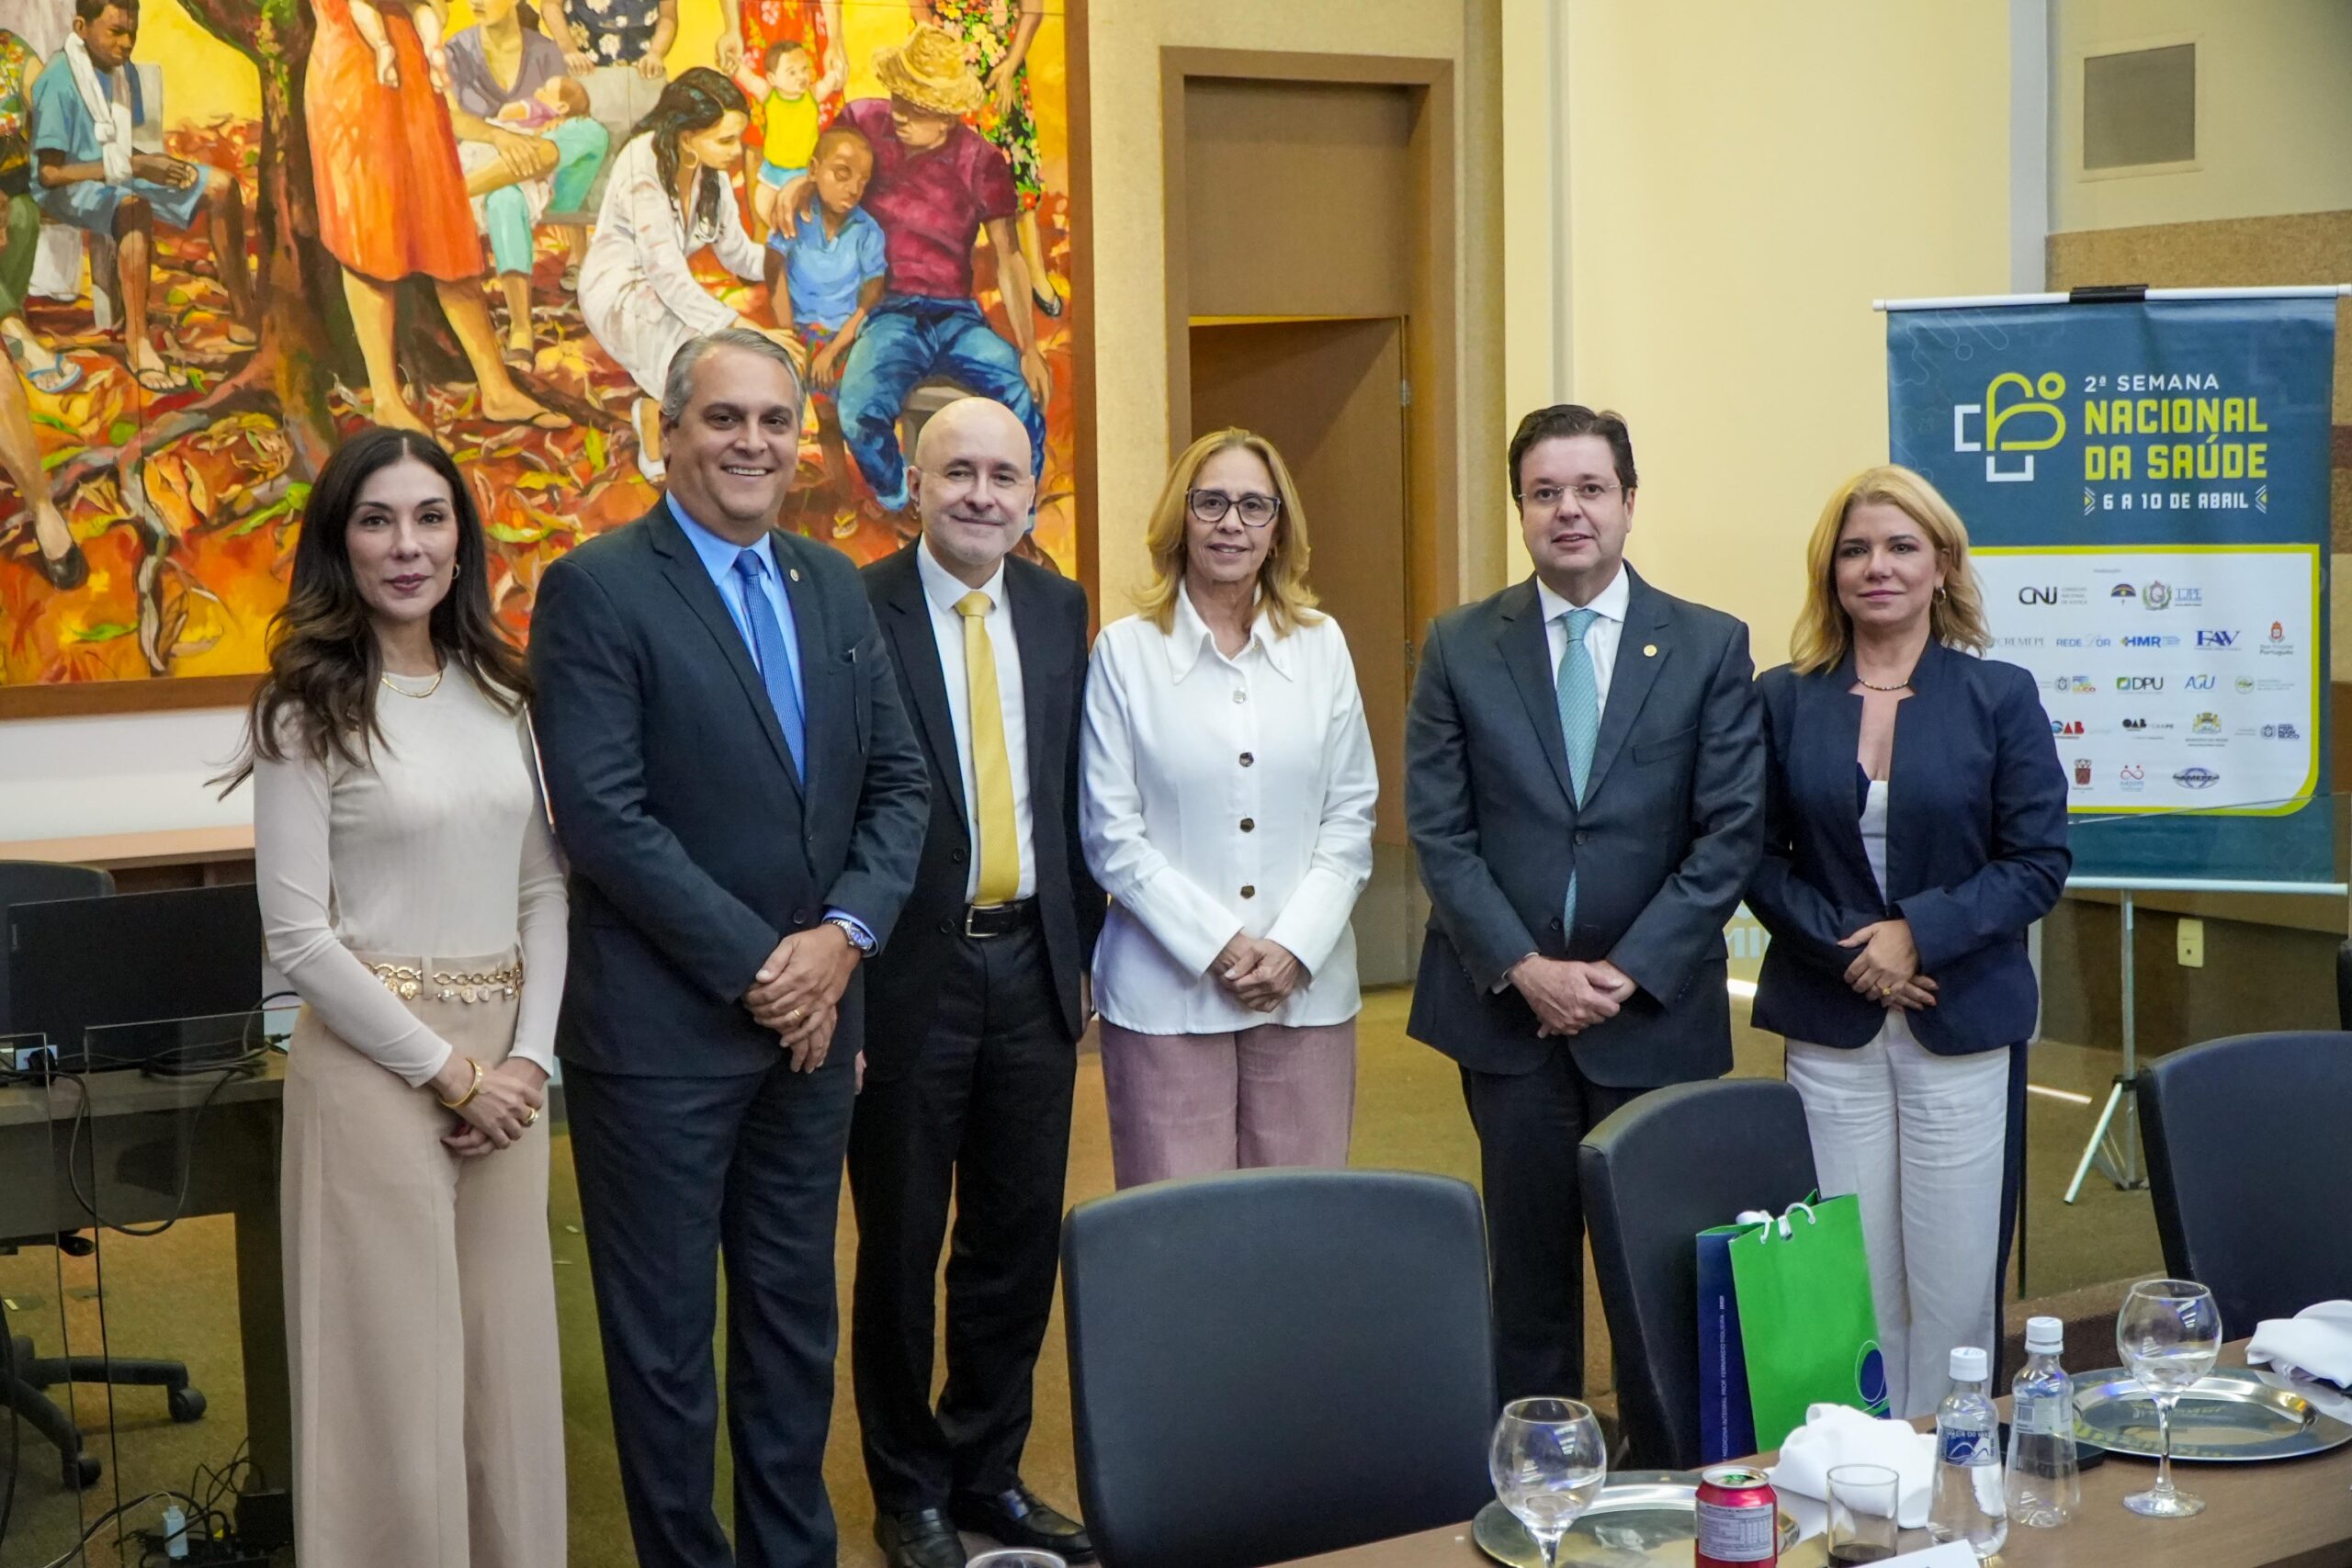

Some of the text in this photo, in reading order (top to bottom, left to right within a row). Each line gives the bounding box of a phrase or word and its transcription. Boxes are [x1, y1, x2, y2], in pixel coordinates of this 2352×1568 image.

[2084, 373, 2220, 393] 2ª SEMANA
[2085, 397, 2268, 435] NACIONAL
[2085, 434, 2267, 480] DA SAÚDE
[2103, 492, 2249, 510] 6 A 10 DE ABRIL
[2018, 586, 2058, 605] CNJ
[2056, 638, 2082, 648] REDE
[2125, 636, 2162, 649] HMR
[2195, 630, 2241, 647] FAV
[2132, 676, 2164, 691] DPU
[2122, 718, 2147, 728] OAB
